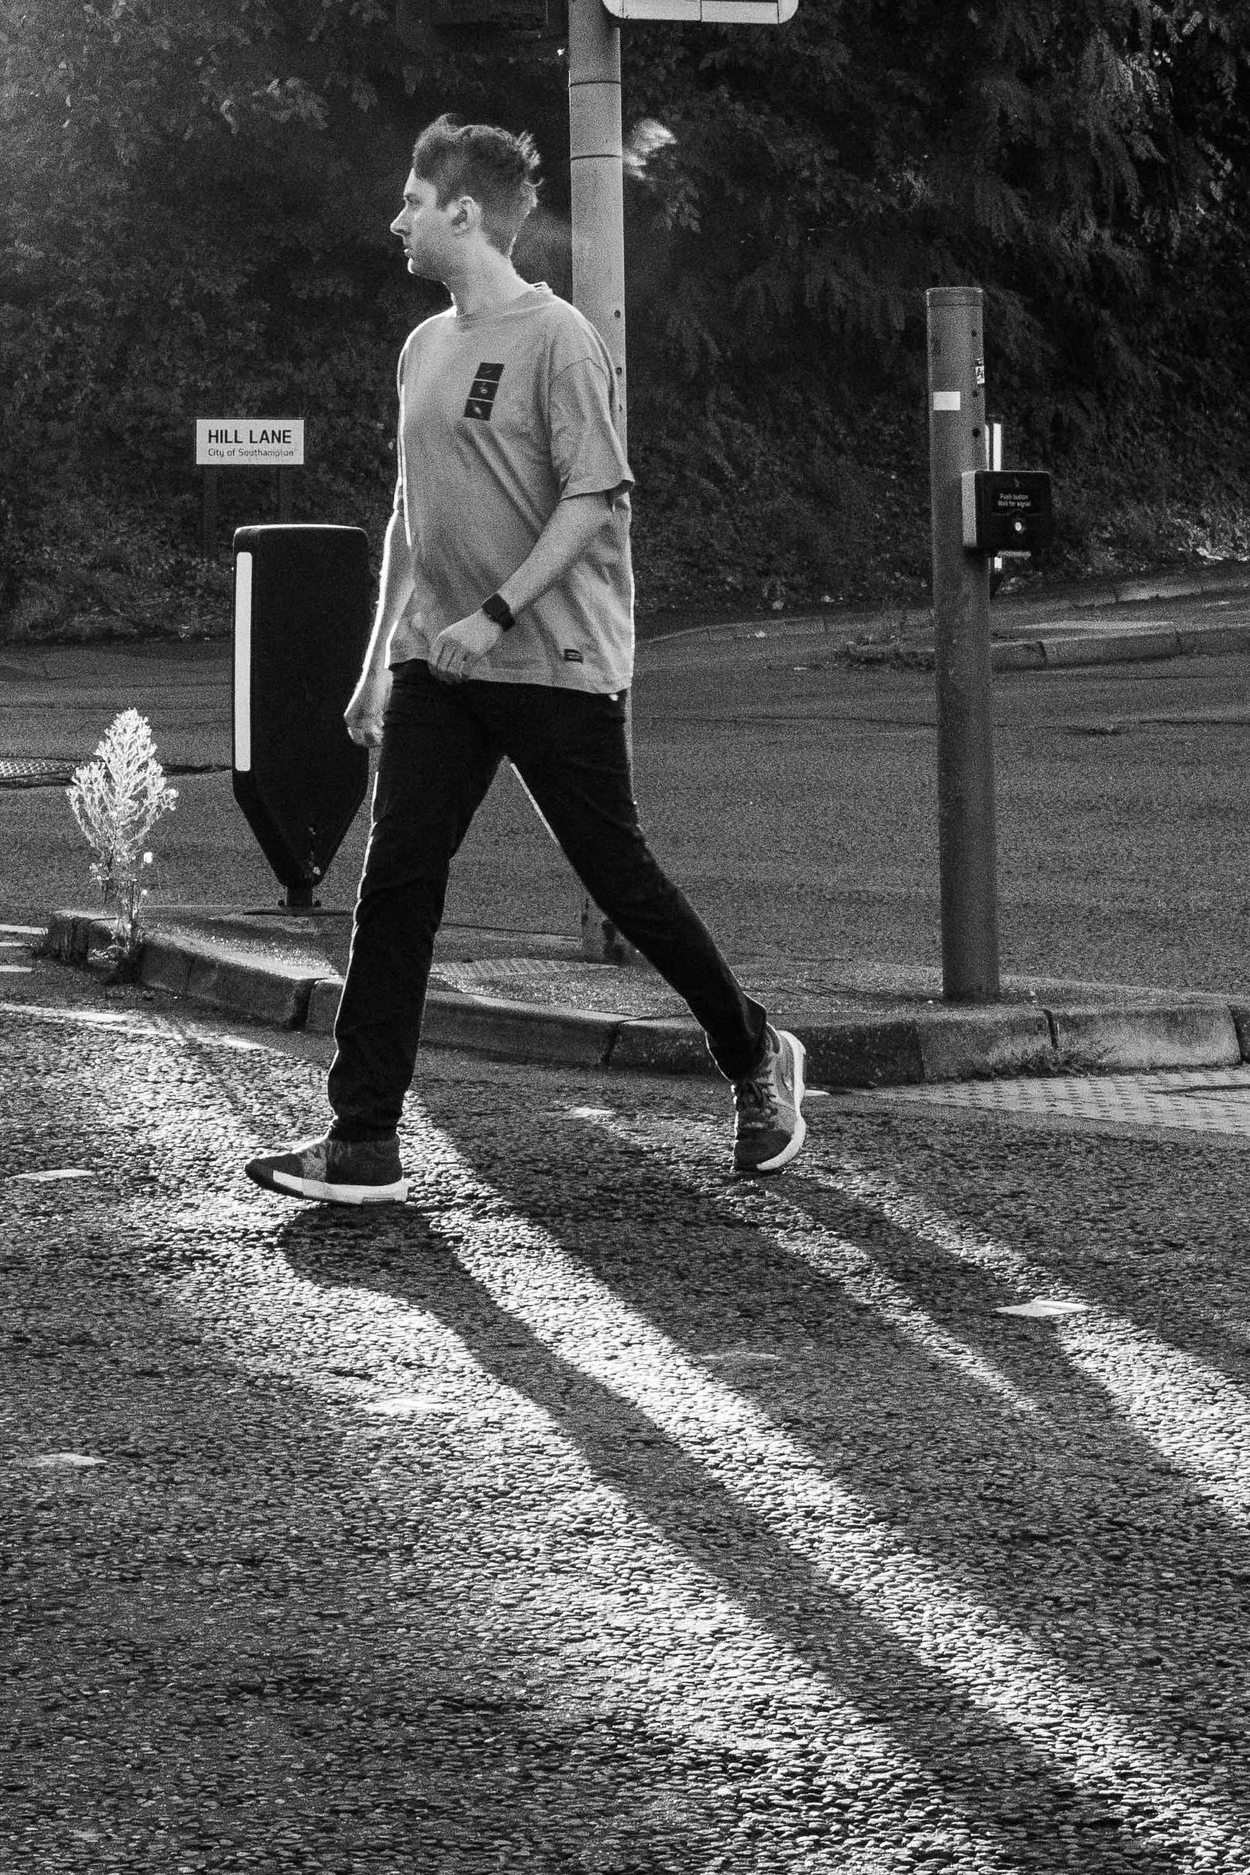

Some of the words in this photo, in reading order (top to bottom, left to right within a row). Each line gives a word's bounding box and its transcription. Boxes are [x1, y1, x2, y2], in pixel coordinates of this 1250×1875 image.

[208, 429, 243, 444] HILL
[249, 429, 292, 444] LANE
[207, 448, 225, 458] City
[226, 448, 236, 457] of
[238, 448, 294, 458] Southampton
